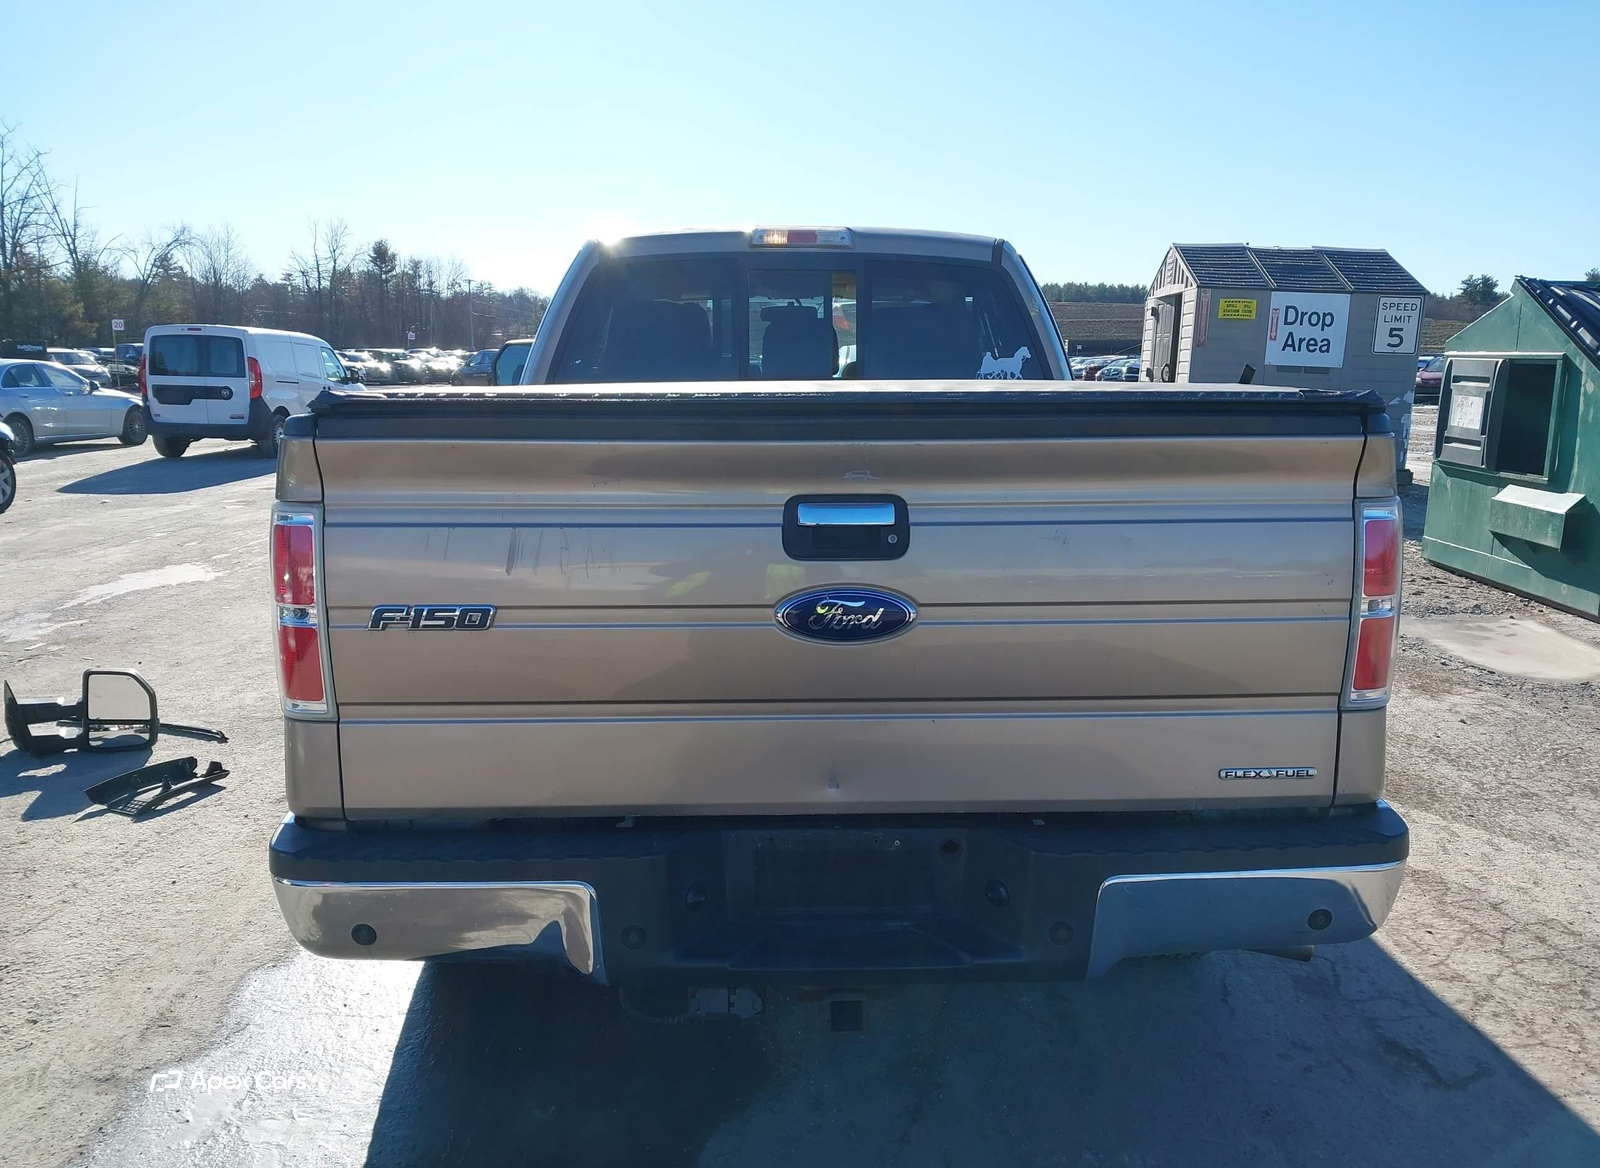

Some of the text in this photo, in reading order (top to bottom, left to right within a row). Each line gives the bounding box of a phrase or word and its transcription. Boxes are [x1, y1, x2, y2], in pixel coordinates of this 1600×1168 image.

[1381, 302, 1418, 311] SPEED
[1283, 305, 1335, 331] Drop
[1383, 314, 1413, 324] LIMIT
[1281, 331, 1331, 353] Area
[1386, 327, 1404, 348] 5
[365, 604, 497, 631] F-150
[807, 599, 885, 630] Ford
[1224, 769, 1315, 779] FLEX FUEL
